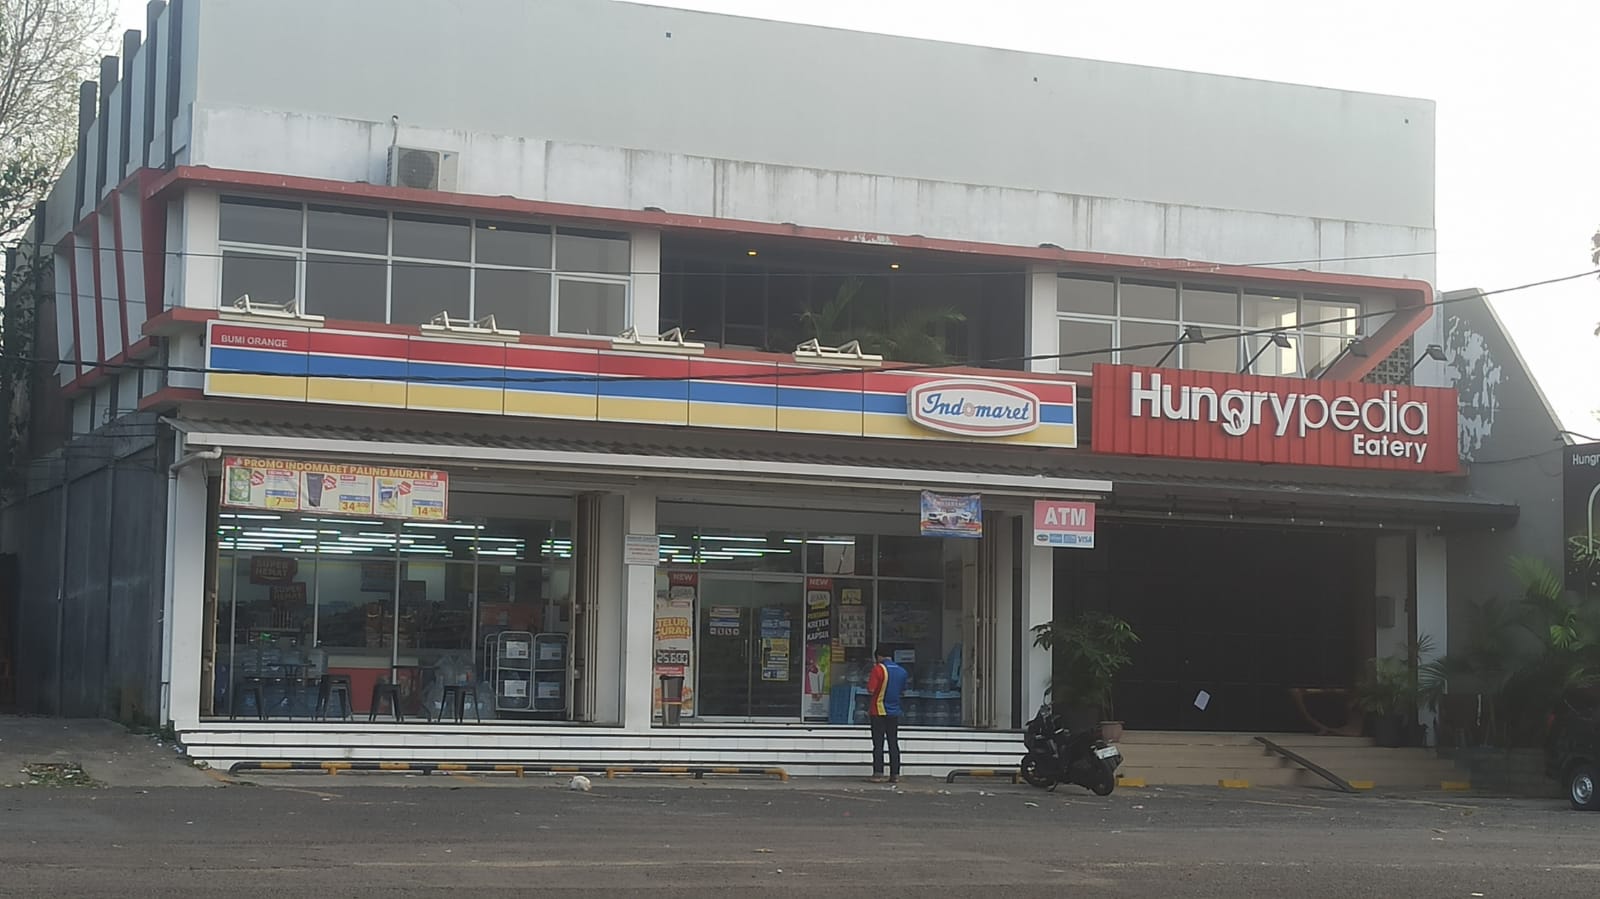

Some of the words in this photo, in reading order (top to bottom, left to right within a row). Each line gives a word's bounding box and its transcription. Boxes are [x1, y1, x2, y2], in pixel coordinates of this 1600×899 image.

[221, 335, 245, 344] BUMI
[247, 336, 288, 348] ORANGE
[922, 393, 1030, 420] Indomaret
[1131, 371, 1429, 437] Hungrypedia
[1353, 434, 1428, 463] Eatery
[244, 459, 284, 469] PROMO
[285, 461, 347, 474] INDOMARET
[350, 466, 388, 477] PALING
[389, 469, 428, 480] MURAH
[1044, 506, 1086, 526] ATM
[673, 573, 693, 581] NEW
[810, 578, 829, 586] NEW
[657, 618, 688, 627] TELUR
